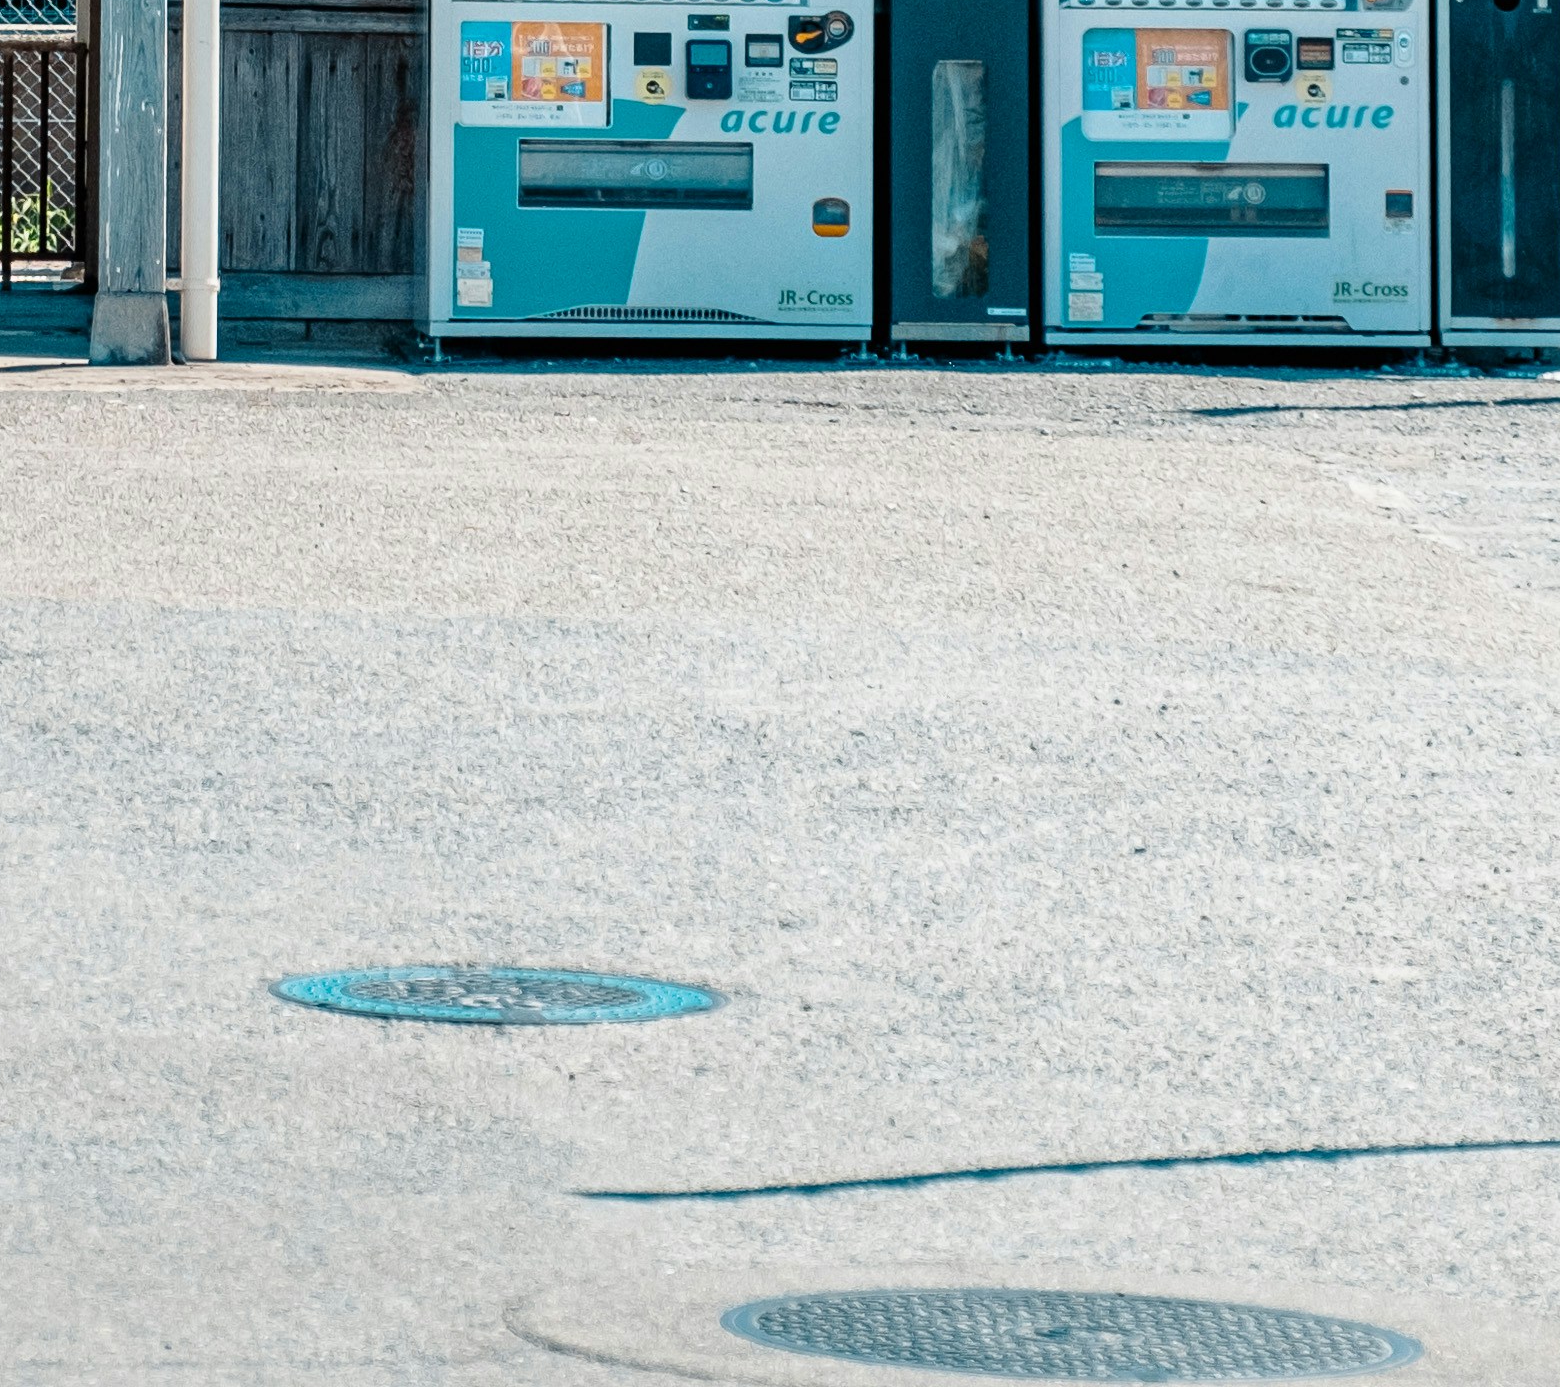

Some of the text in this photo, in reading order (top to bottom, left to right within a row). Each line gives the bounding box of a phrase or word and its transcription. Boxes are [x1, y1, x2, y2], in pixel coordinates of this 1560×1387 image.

[720, 109, 841, 135] acure
[1273, 104, 1395, 130] acure
[778, 289, 854, 306] JR-Cross
[1333, 281, 1409, 297] JR-Cross
